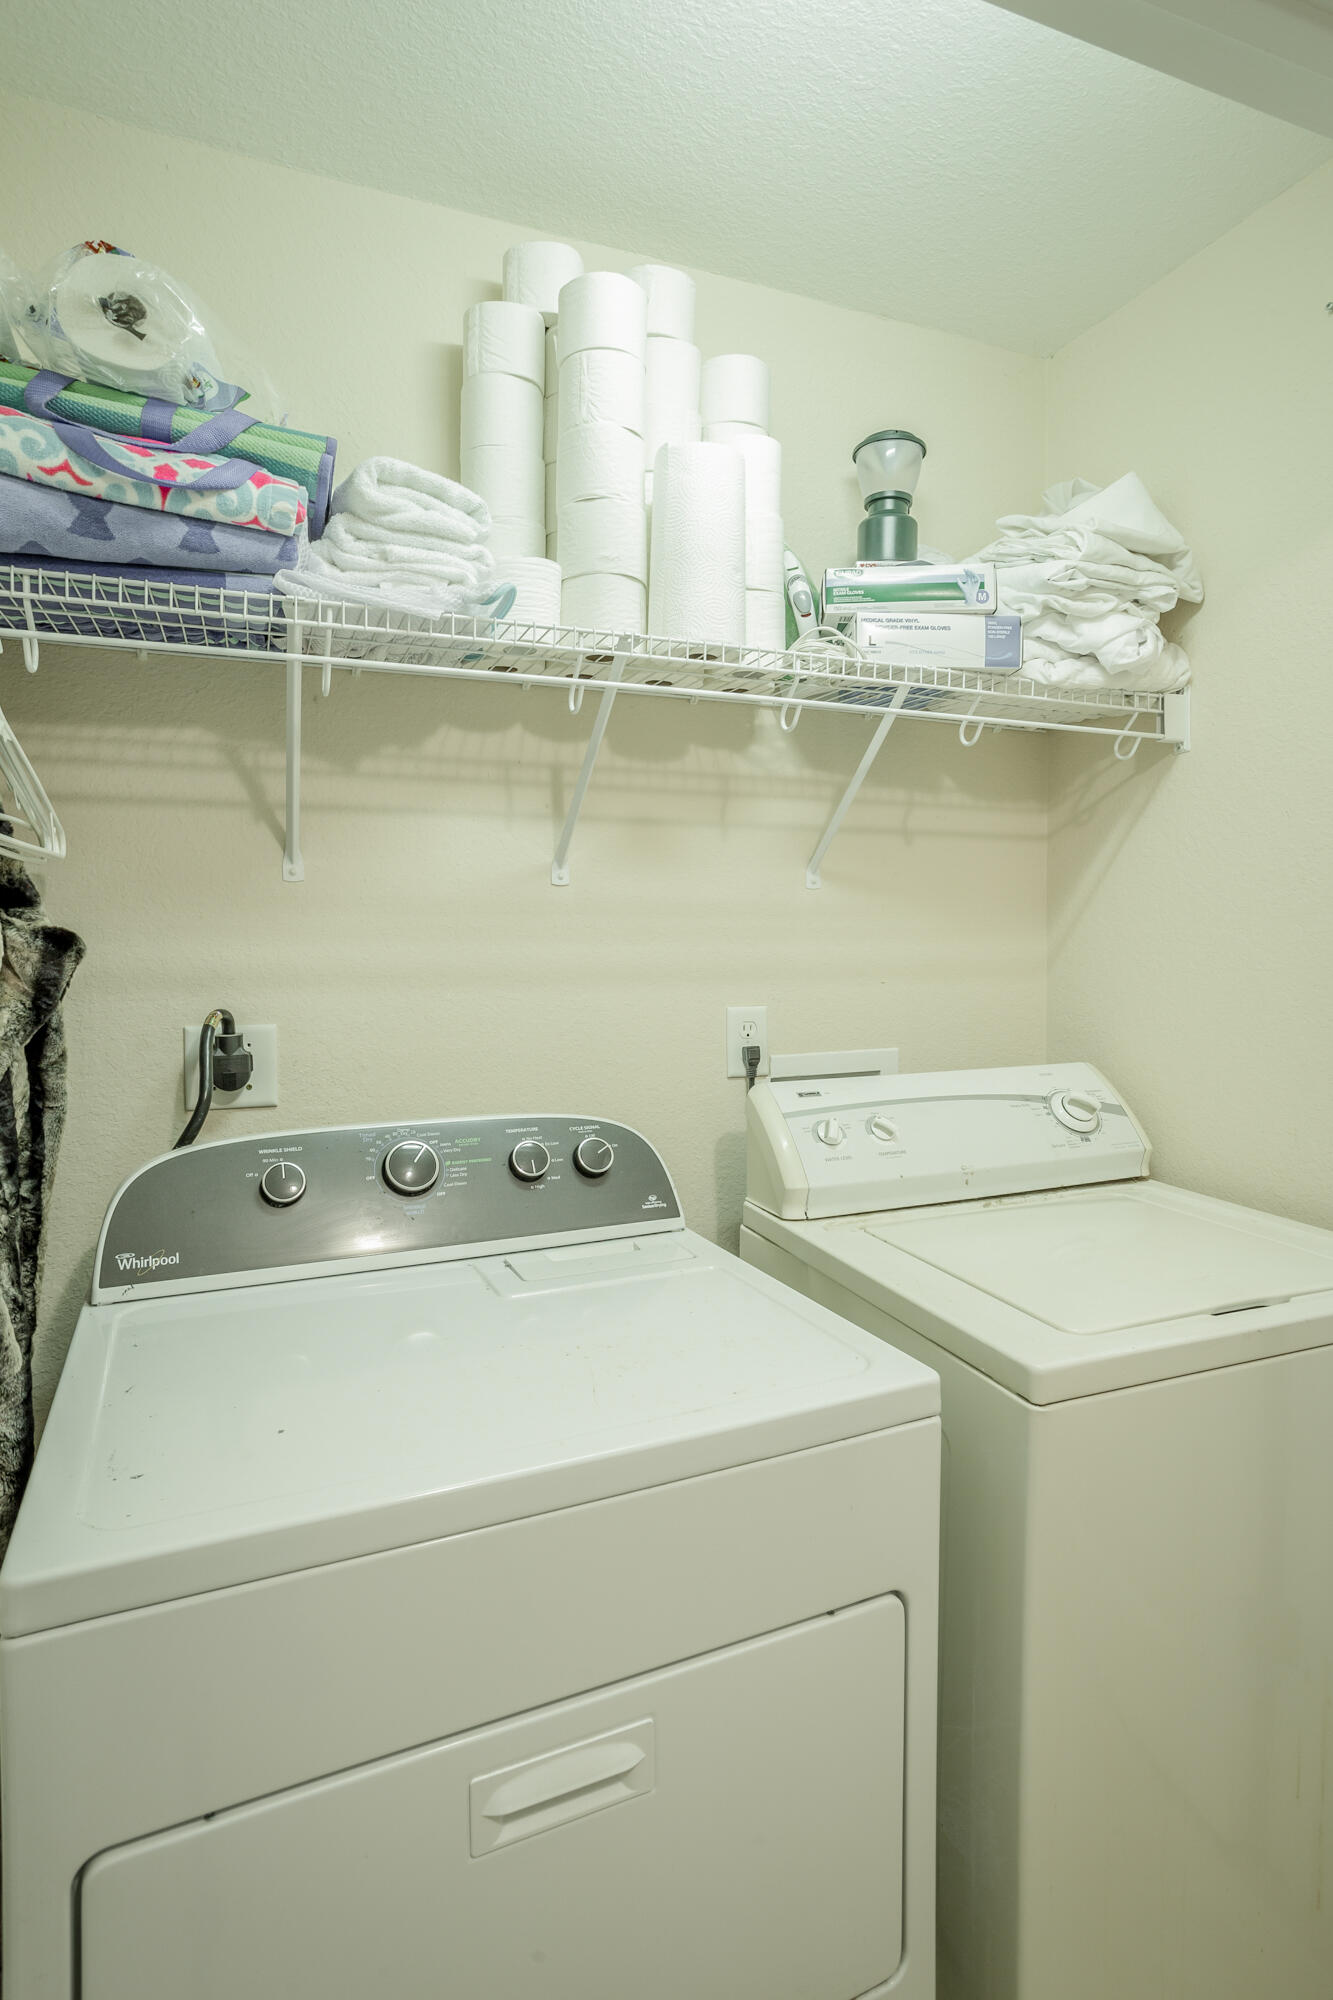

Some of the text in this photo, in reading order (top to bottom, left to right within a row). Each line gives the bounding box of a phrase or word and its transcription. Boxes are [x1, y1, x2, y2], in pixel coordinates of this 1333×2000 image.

[978, 592, 987, 601] M
[868, 635, 877, 646] L
[117, 1252, 180, 1271] Whirlpool
